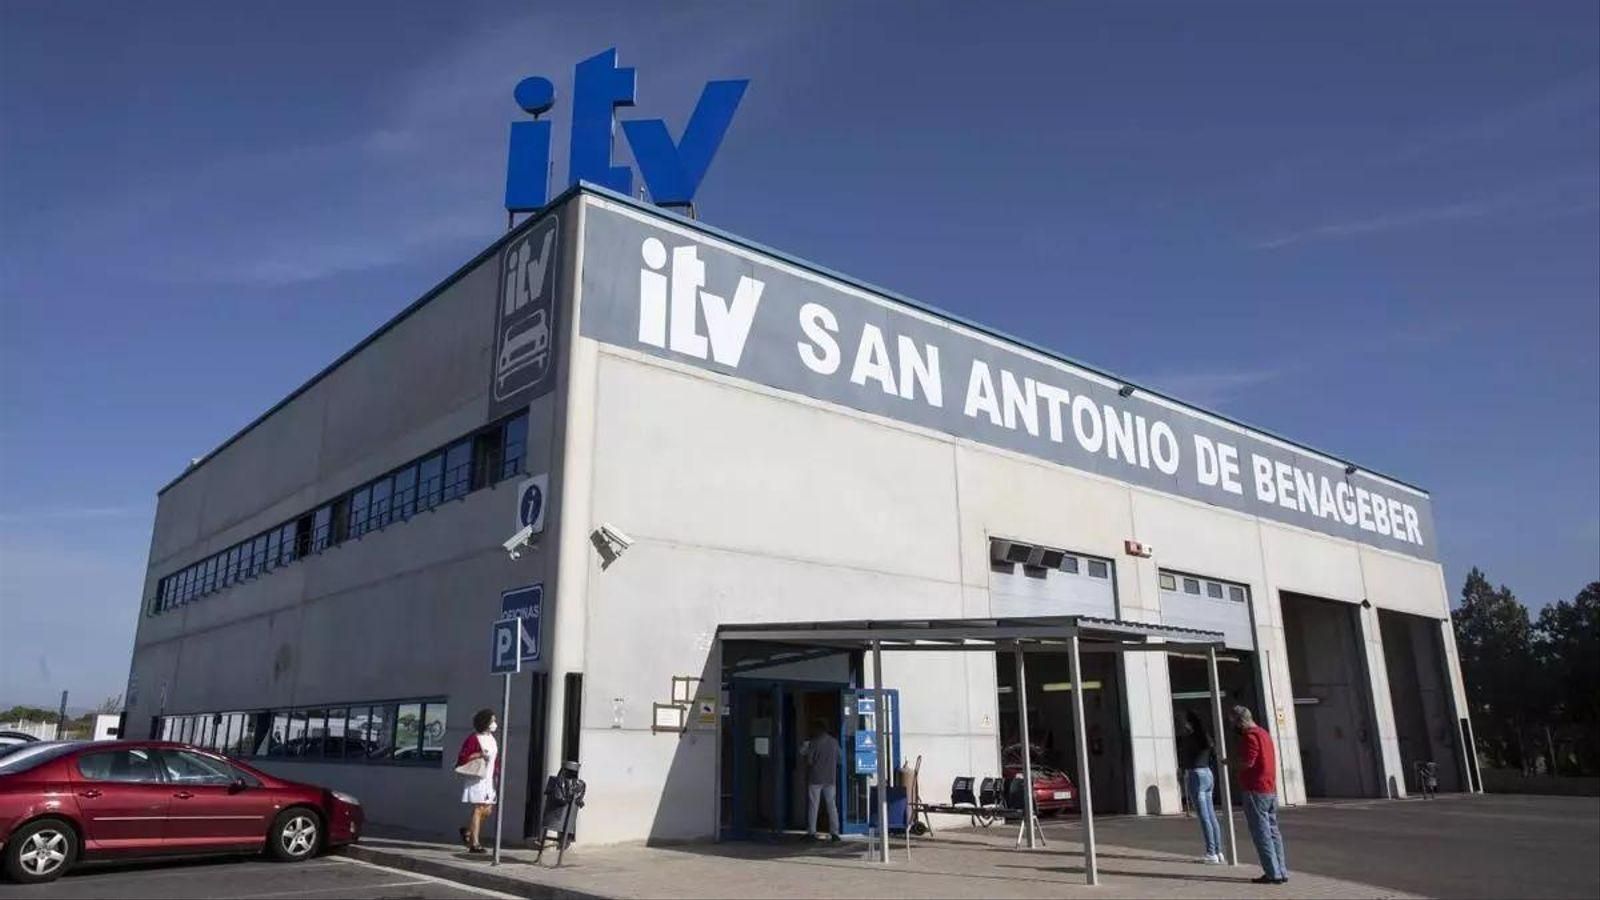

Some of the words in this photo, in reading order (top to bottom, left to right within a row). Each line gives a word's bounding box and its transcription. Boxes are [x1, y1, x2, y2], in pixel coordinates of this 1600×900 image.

[504, 47, 750, 212] itv
[505, 228, 555, 316] itv
[638, 237, 765, 368] itv
[797, 303, 943, 408] SAN
[964, 359, 1180, 476] ANTONIO
[1194, 433, 1243, 495] DE
[1252, 454, 1424, 546] BENAGEBER
[496, 627, 512, 667] P
